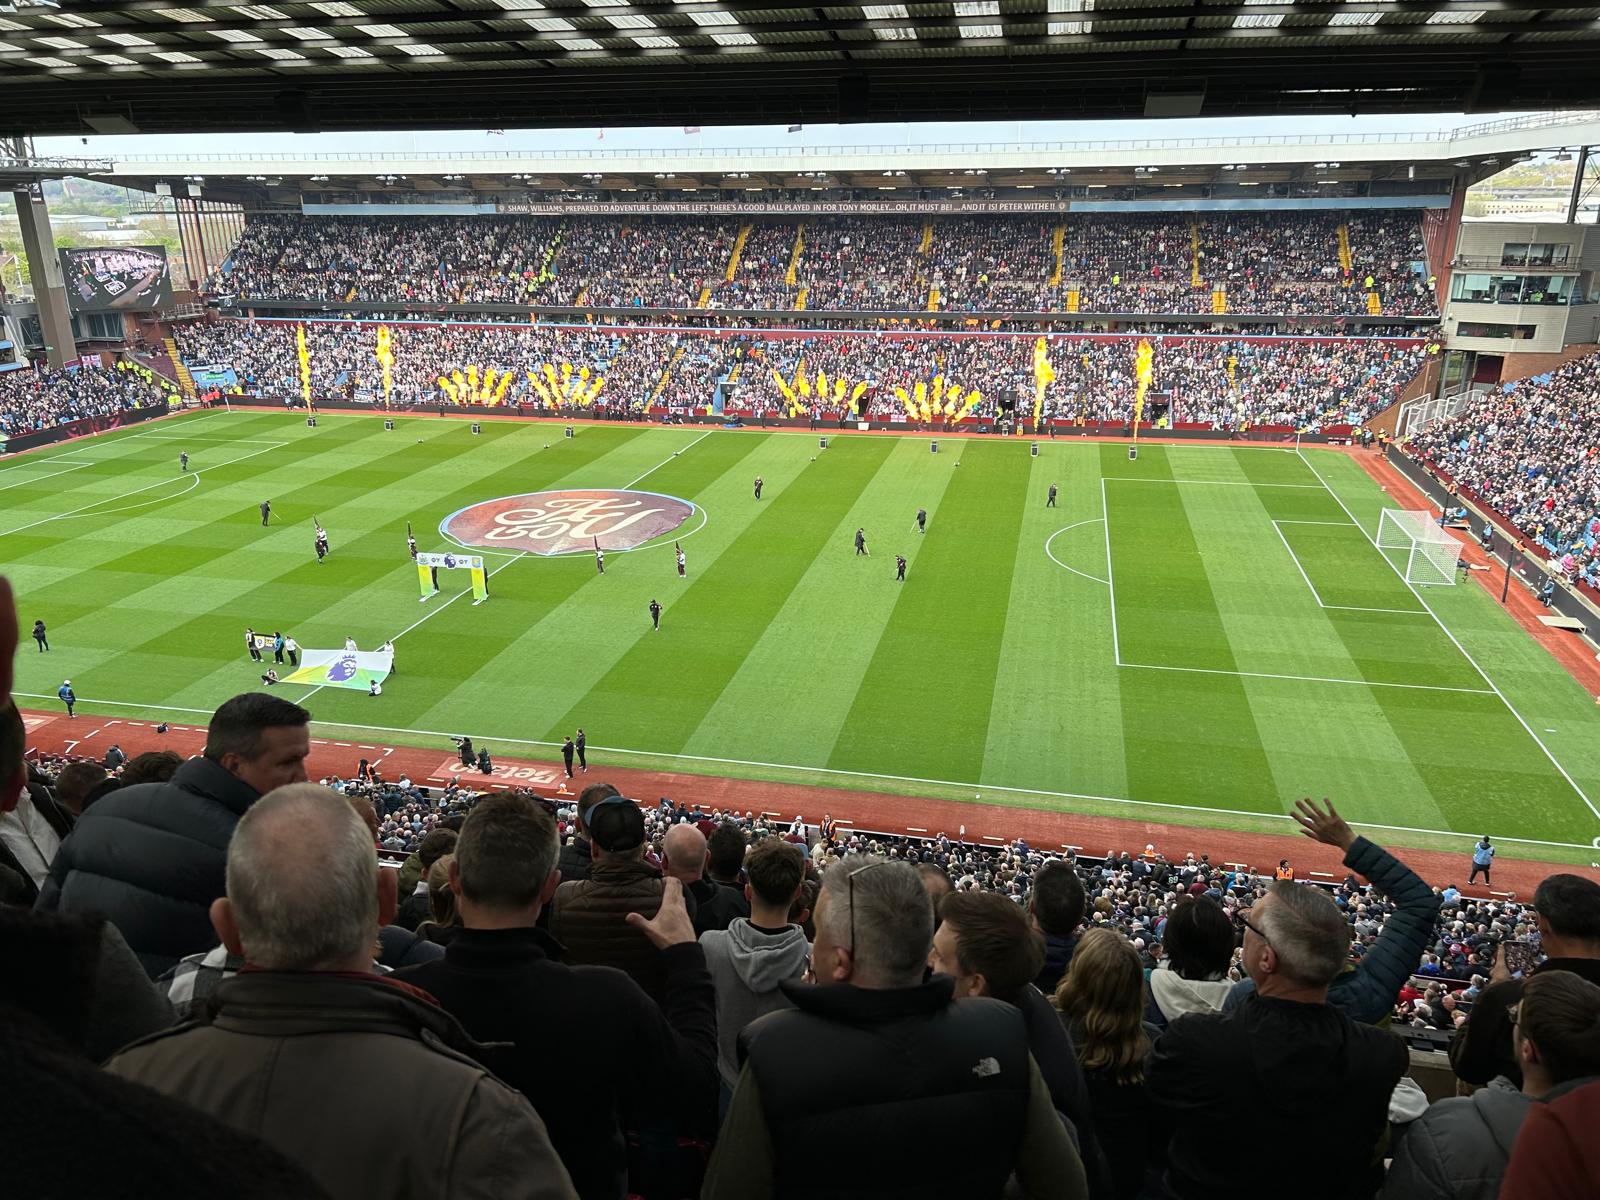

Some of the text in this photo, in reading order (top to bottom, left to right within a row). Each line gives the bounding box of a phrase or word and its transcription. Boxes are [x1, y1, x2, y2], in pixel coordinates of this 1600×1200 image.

[610, 204, 650, 212] ADVENTURE
[918, 203, 939, 211] MUST
[979, 203, 986, 211] IT
[999, 203, 1022, 211] PETER
